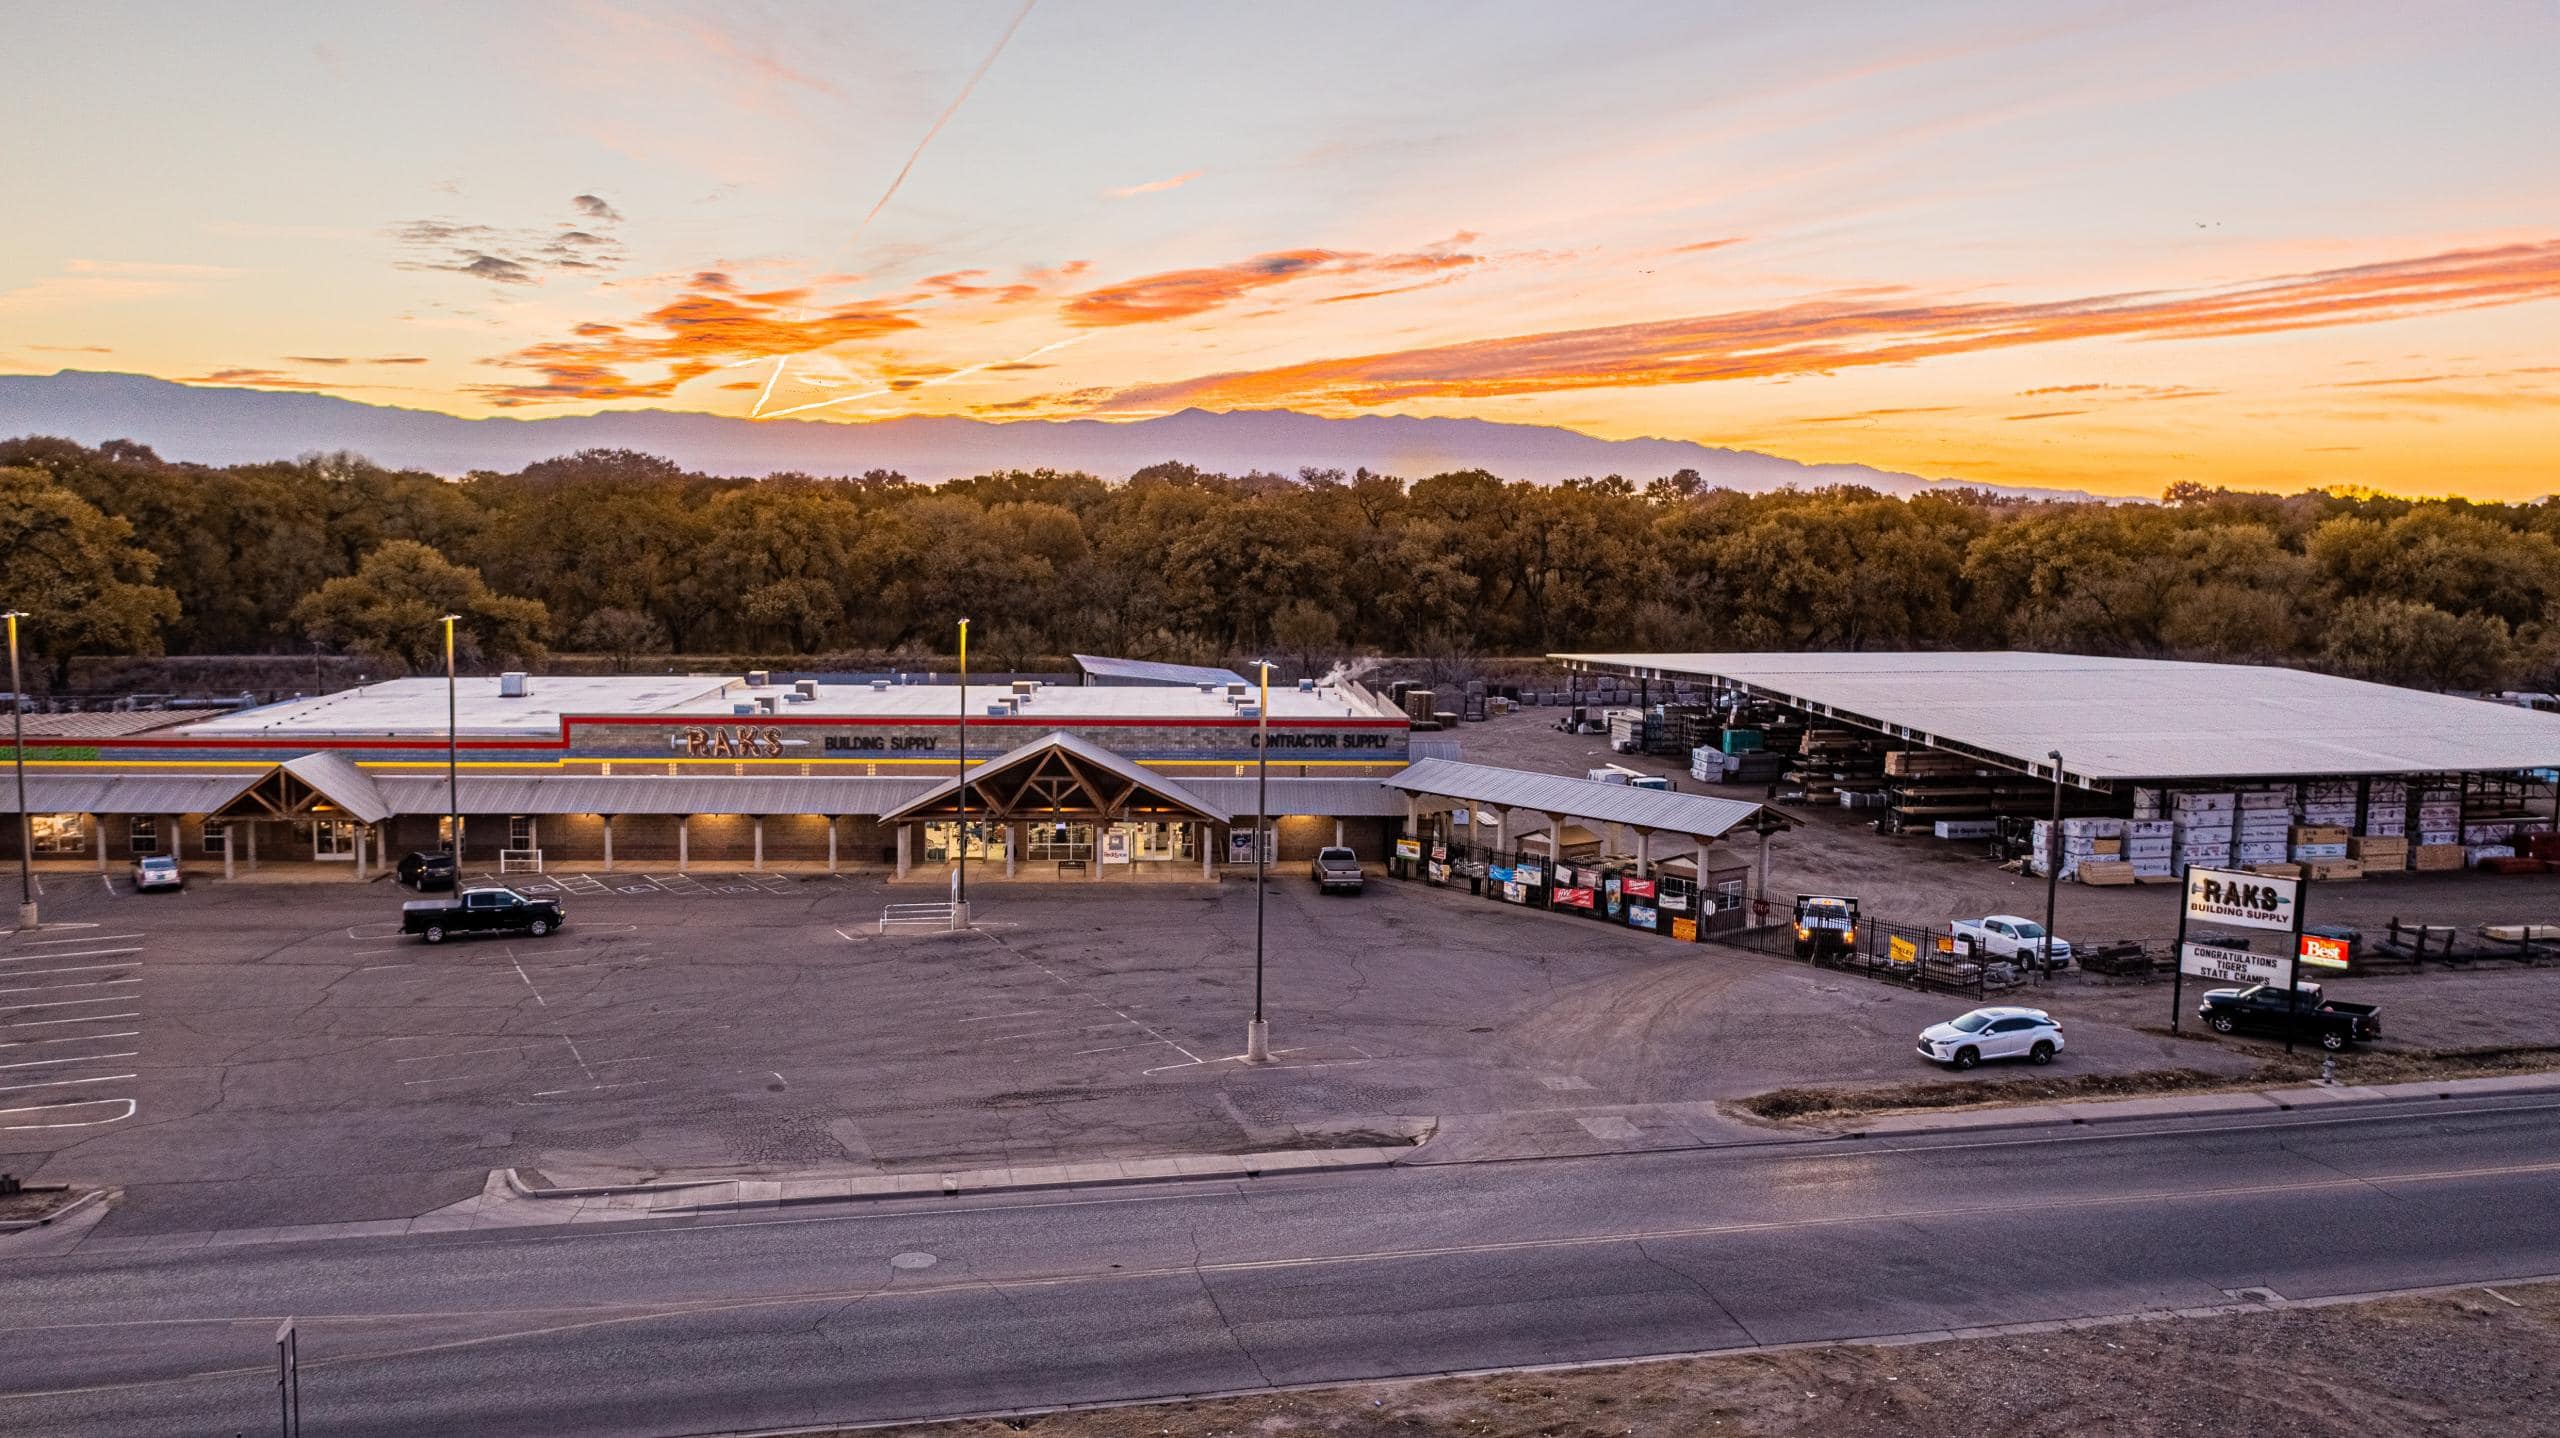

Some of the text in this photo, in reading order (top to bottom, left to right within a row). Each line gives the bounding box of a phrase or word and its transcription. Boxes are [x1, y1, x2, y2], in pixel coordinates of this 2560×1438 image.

[684, 726, 785, 758] RAKS
[825, 736, 938, 750] BUILDING SUPPLY
[1251, 734, 1389, 748] CNTRACTOR SUPPLY
[2203, 879, 2278, 911] RAKS
[2191, 903, 2289, 923] BUILDING SUPPLY
[2194, 947, 2278, 969] CONGRATULATIONS
[2307, 941, 2341, 960] Best
[2201, 967, 2270, 985] STATE CHAMPS
[2217, 960, 2247, 973] TIGERS
